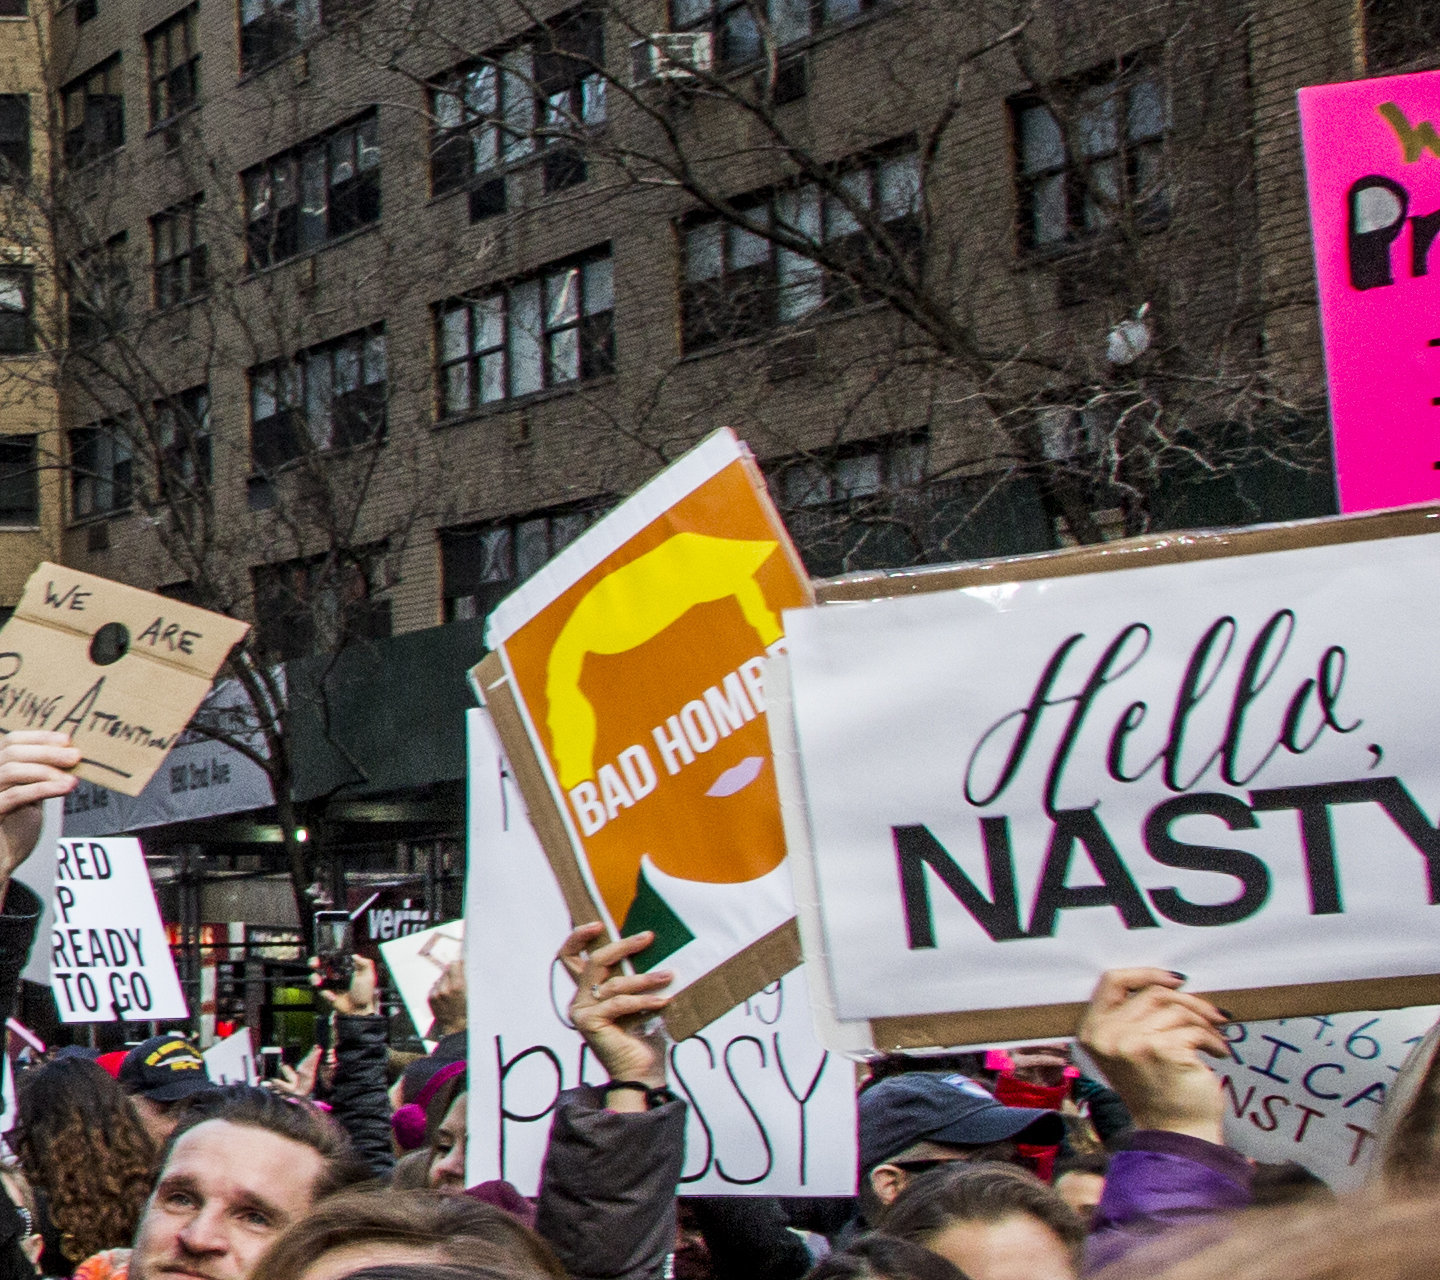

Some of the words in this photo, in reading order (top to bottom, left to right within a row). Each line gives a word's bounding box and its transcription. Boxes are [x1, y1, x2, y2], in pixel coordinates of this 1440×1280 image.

[44, 580, 92, 611] WE
[137, 617, 203, 656] ARE
[964, 609, 1383, 821] Hello,
[568, 744, 658, 837] BAD
[53, 928, 145, 967] READY
[55, 972, 99, 1012] TO
[109, 971, 152, 1012] GO
